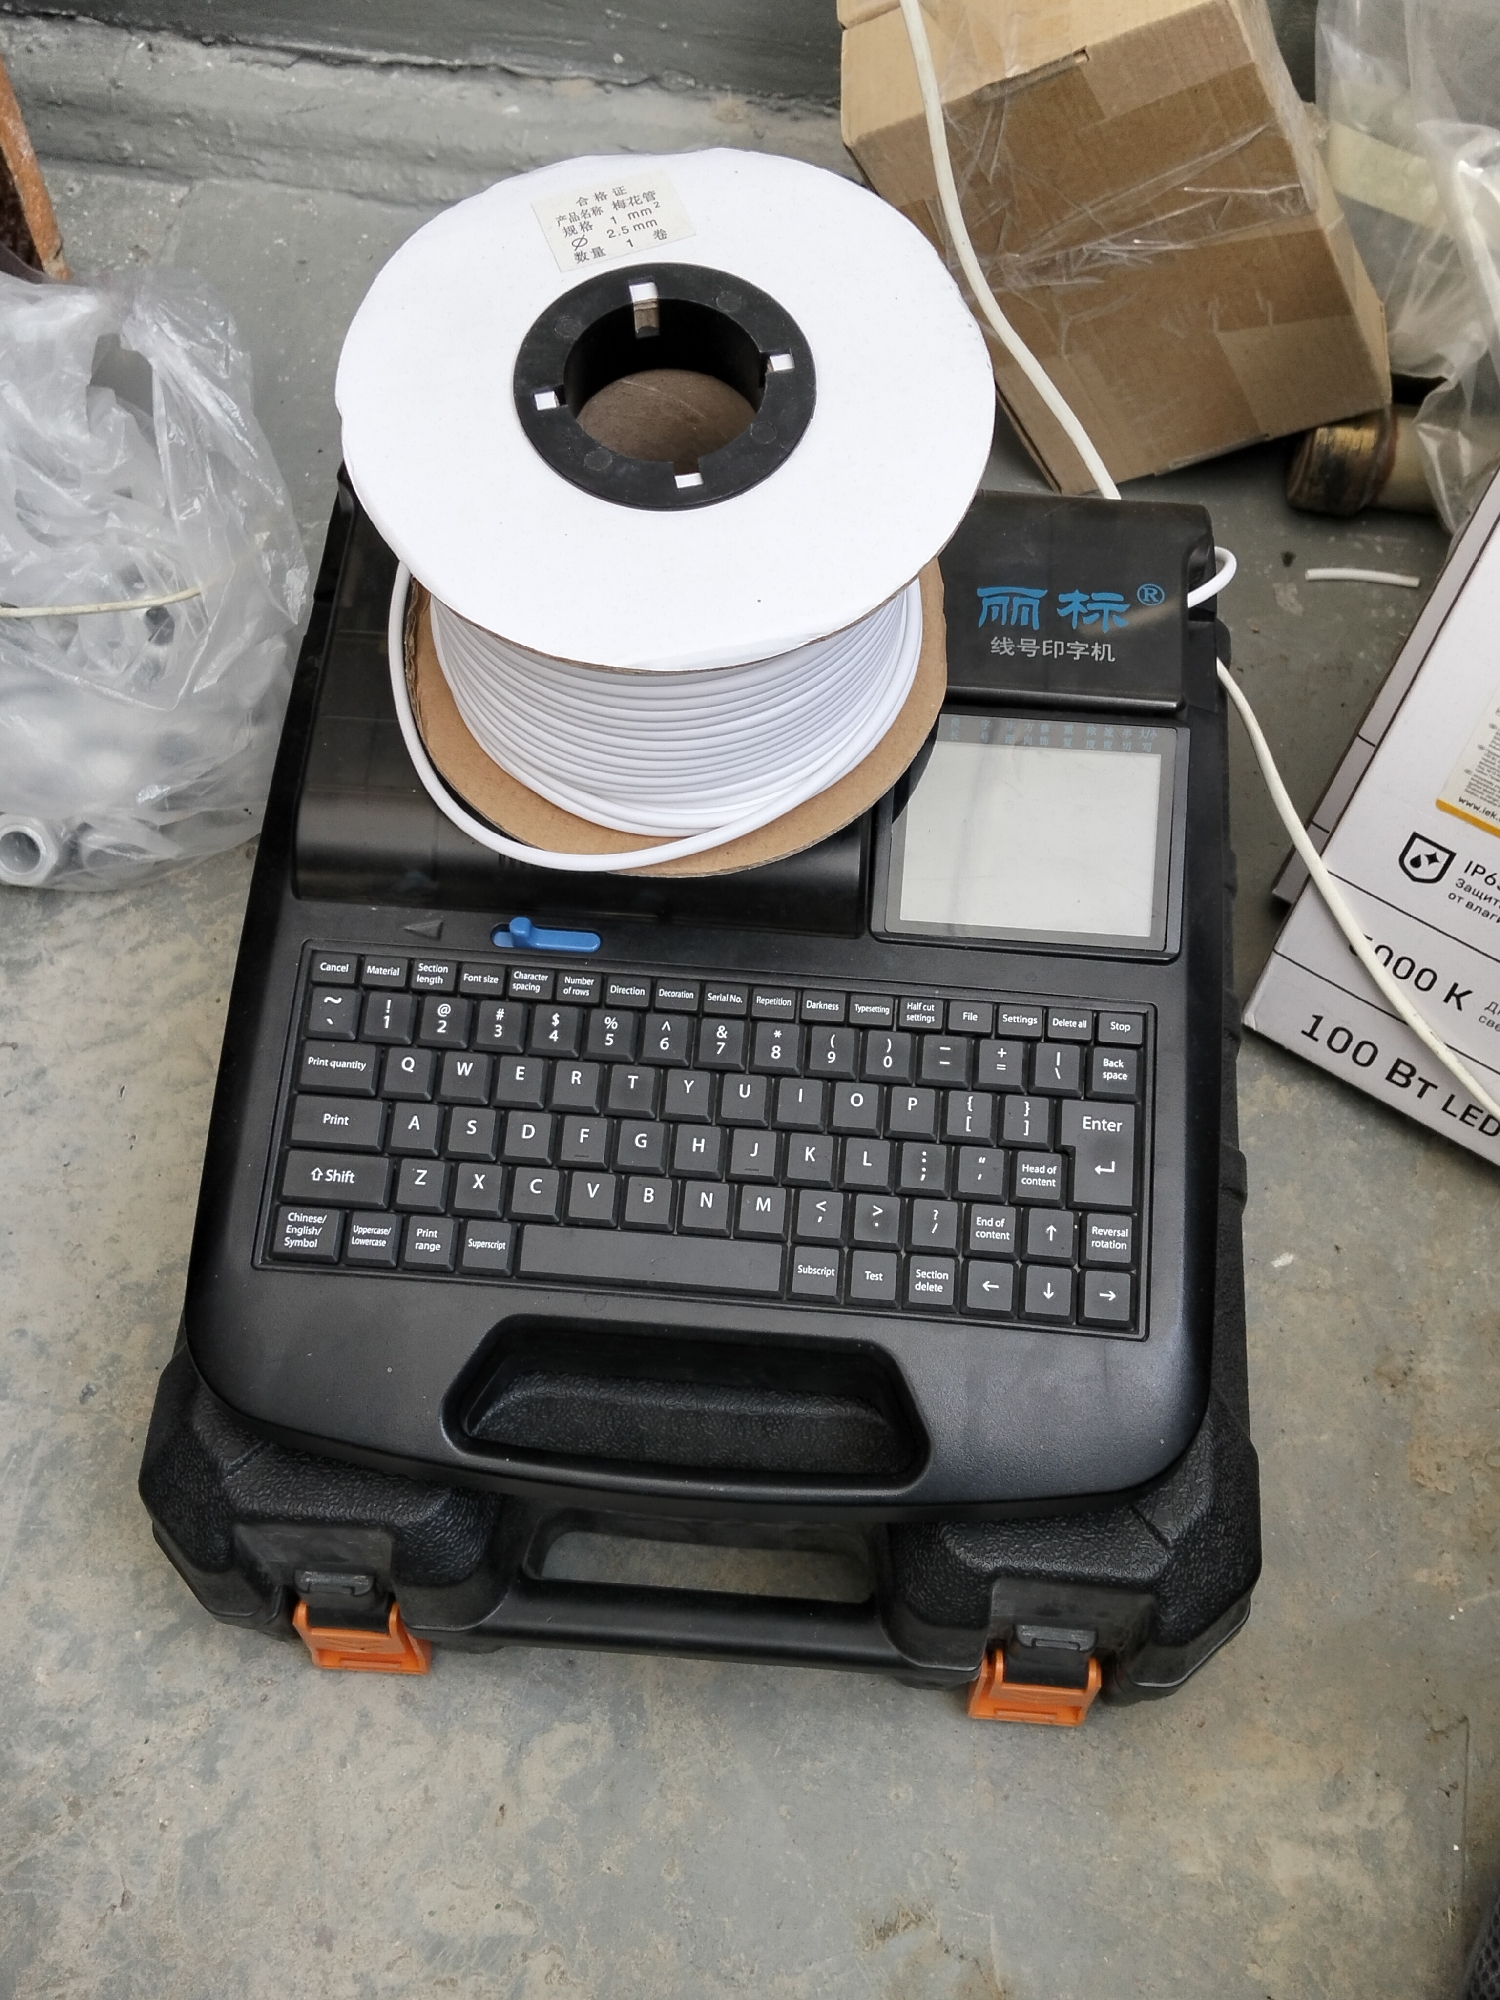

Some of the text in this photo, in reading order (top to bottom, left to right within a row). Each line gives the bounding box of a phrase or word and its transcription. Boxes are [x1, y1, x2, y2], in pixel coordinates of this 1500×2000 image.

[575, 186, 628, 207] 合格证
[556, 190, 657, 227] 产品名称 梅花管
[562, 222, 594, 238] 规格
[606, 225, 629, 239] 2.5
[632, 219, 658, 232] mm
[573, 228, 668, 264] 数量 1 卷
[991, 637, 1115, 662] 线号印字机
[1458, 796, 1500, 821] www.iek.
[1464, 860, 1500, 891] IP6
[1448, 892, 1464, 903] от
[1455, 878, 1500, 909] Защит
[320, 962, 349, 972] Cancel
[367, 966, 399, 975] Material
[418, 963, 448, 973] Section
[417, 974, 443, 985] length
[464, 973, 498, 983] Font size
[514, 971, 548, 981] Character
[565, 977, 594, 985] Number
[513, 983, 540, 993] spacing
[610, 985, 645, 995] Direction
[659, 989, 693, 998] Decoration
[708, 993, 742, 1003] Serial No.
[757, 996, 791, 1006] Repetition
[437, 1004, 451, 1017] @
[806, 1000, 839, 1010] Darkness
[855, 1004, 889, 1015] Typesetting
[907, 1002, 922, 1010] Half
[1484, 1001, 1500, 1015] Д
[496, 1009, 504, 1020] #
[552, 1013, 559, 1026] $
[907, 1014, 935, 1023] settings
[963, 1012, 978, 1021] File
[1003, 1014, 1037, 1025] Settings
[384, 1016, 389, 1028] 1
[437, 1020, 447, 1033] 2
[605, 1017, 618, 1029] %
[1053, 1018, 1086, 1028] Delete all
[1111, 1022, 1130, 1032] Stop
[495, 1025, 502, 1037] 3
[549, 1030, 558, 1042] 4
[717, 1026, 727, 1038] &
[605, 1034, 613, 1045] 5
[660, 1038, 669, 1050] 6
[717, 1042, 725, 1054] 7
[771, 1045, 781, 1059] 8
[828, 1051, 835, 1063] 9
[1104, 1058, 1124, 1068] Back
[308, 1057, 366, 1072] Print quantity
[402, 1057, 415, 1072] Q
[457, 1062, 473, 1076] W
[516, 1066, 525, 1080] E
[572, 1071, 581, 1084] R
[1103, 1072, 1127, 1080] space
[1300, 1014, 1500, 1138] 100 Вт LED
[628, 1075, 638, 1088] T
[684, 1080, 694, 1093] Y
[740, 1084, 750, 1098] U
[799, 1089, 802, 1102] I
[851, 1093, 863, 1106] O
[908, 1098, 917, 1110] P
[323, 1114, 349, 1125] Print
[408, 1116, 419, 1130] A
[1083, 1116, 1122, 1132] Enter
[467, 1120, 476, 1134] S
[522, 1125, 535, 1138] D
[580, 1129, 589, 1143] F
[635, 1134, 647, 1147] G
[693, 1138, 705, 1152] H
[750, 1143, 758, 1157] J
[805, 1147, 815, 1161] K
[863, 1151, 872, 1166] L
[1022, 1164, 1057, 1174] Head of
[325, 1169, 354, 1183] Shift
[415, 1170, 427, 1185] Z
[473, 1174, 485, 1189] X
[530, 1179, 542, 1193] C
[1021, 1178, 1056, 1187] content
[588, 1183, 599, 1198] V
[644, 1188, 654, 1202] B
[701, 1192, 713, 1208] N
[756, 1197, 770, 1211] M
[288, 1212, 327, 1223] Chinese/
[977, 1217, 1005, 1227] End of
[286, 1225, 322, 1236] English/
[354, 1225, 391, 1235] Uppercase/
[417, 1229, 437, 1238] Print
[976, 1231, 1010, 1240] content
[1092, 1226, 1128, 1237] Reversal
[284, 1237, 317, 1248] Symbol
[352, 1236, 386, 1246] Lowercase
[468, 1239, 505, 1250] Superscript
[1092, 1240, 1126, 1249] rotation
[416, 1243, 440, 1252] range
[798, 1265, 834, 1277] Subscript
[865, 1271, 883, 1281] Test
[916, 1269, 948, 1280] Section
[915, 1282, 943, 1292] delete
